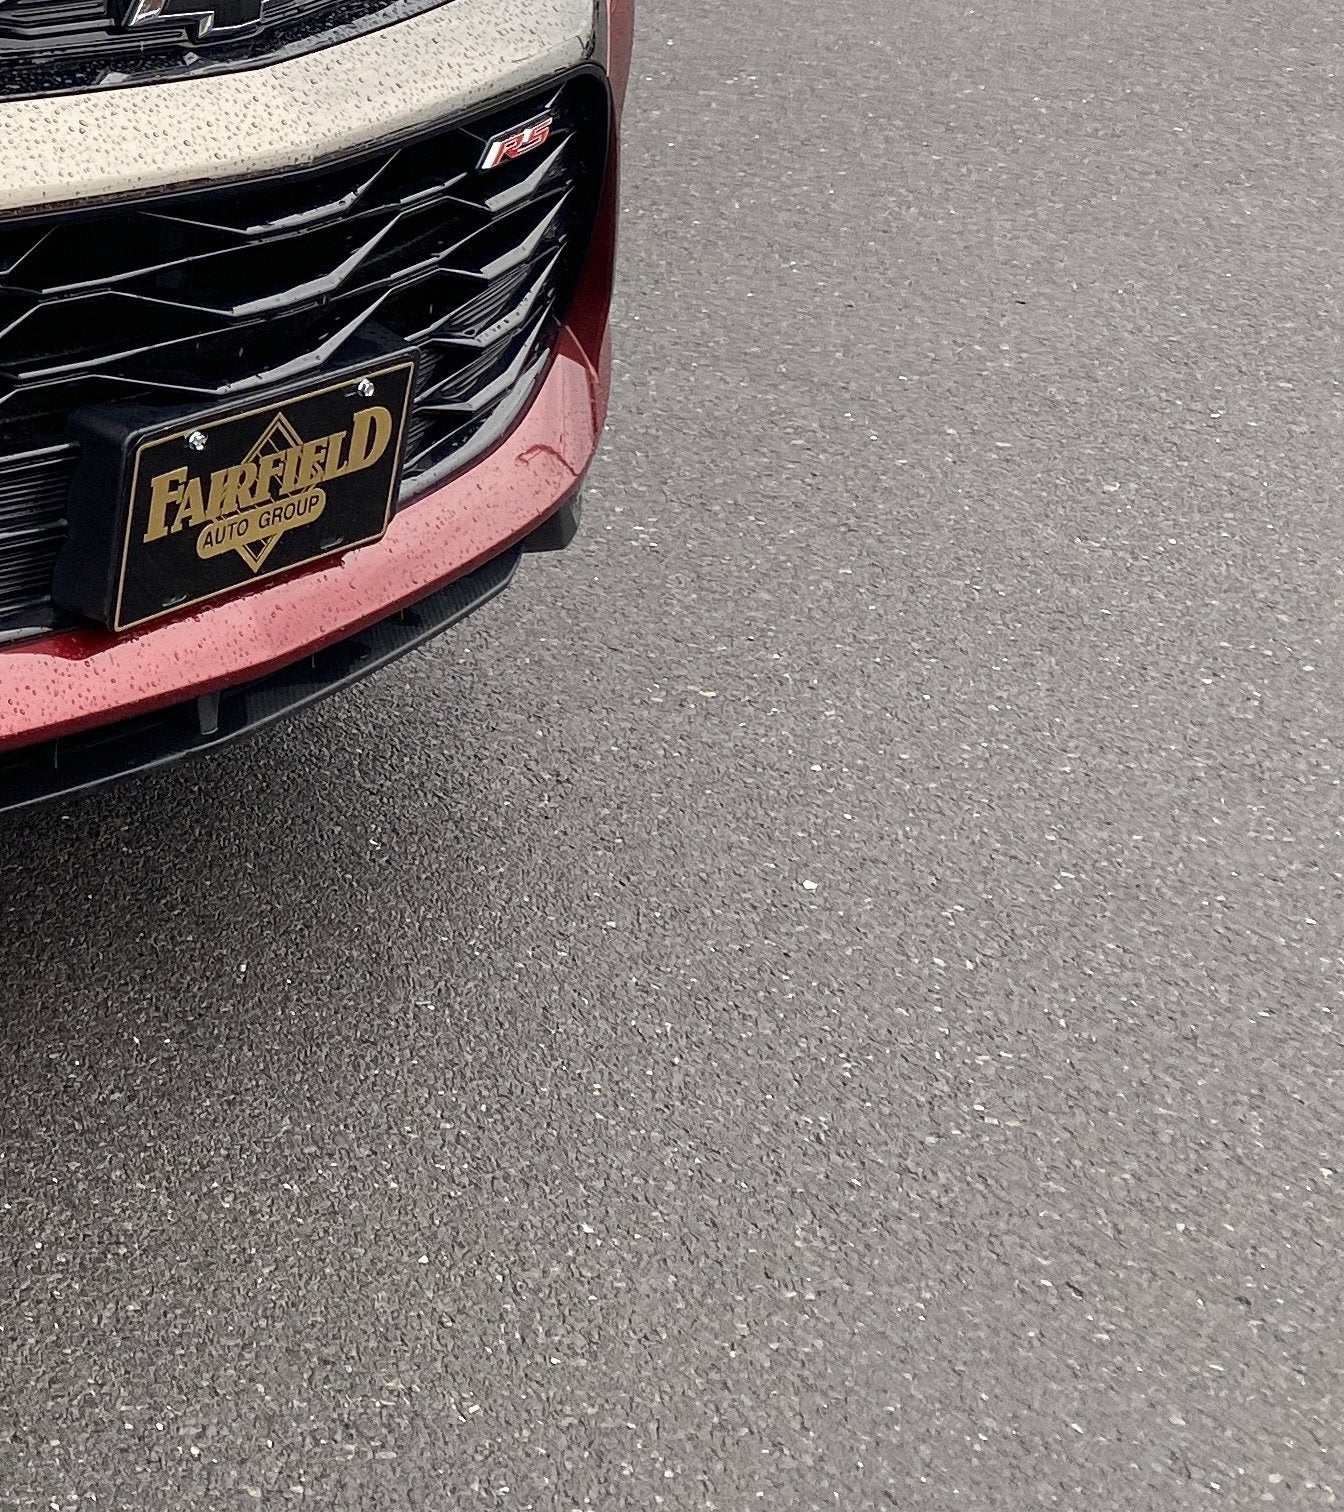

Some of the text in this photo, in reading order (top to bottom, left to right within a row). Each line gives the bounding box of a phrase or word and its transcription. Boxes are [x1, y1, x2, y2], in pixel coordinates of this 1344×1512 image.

[481, 117, 553, 170] RS
[143, 406, 393, 543] FAIRFIELD
[202, 495, 321, 550] AUTO GROUP
